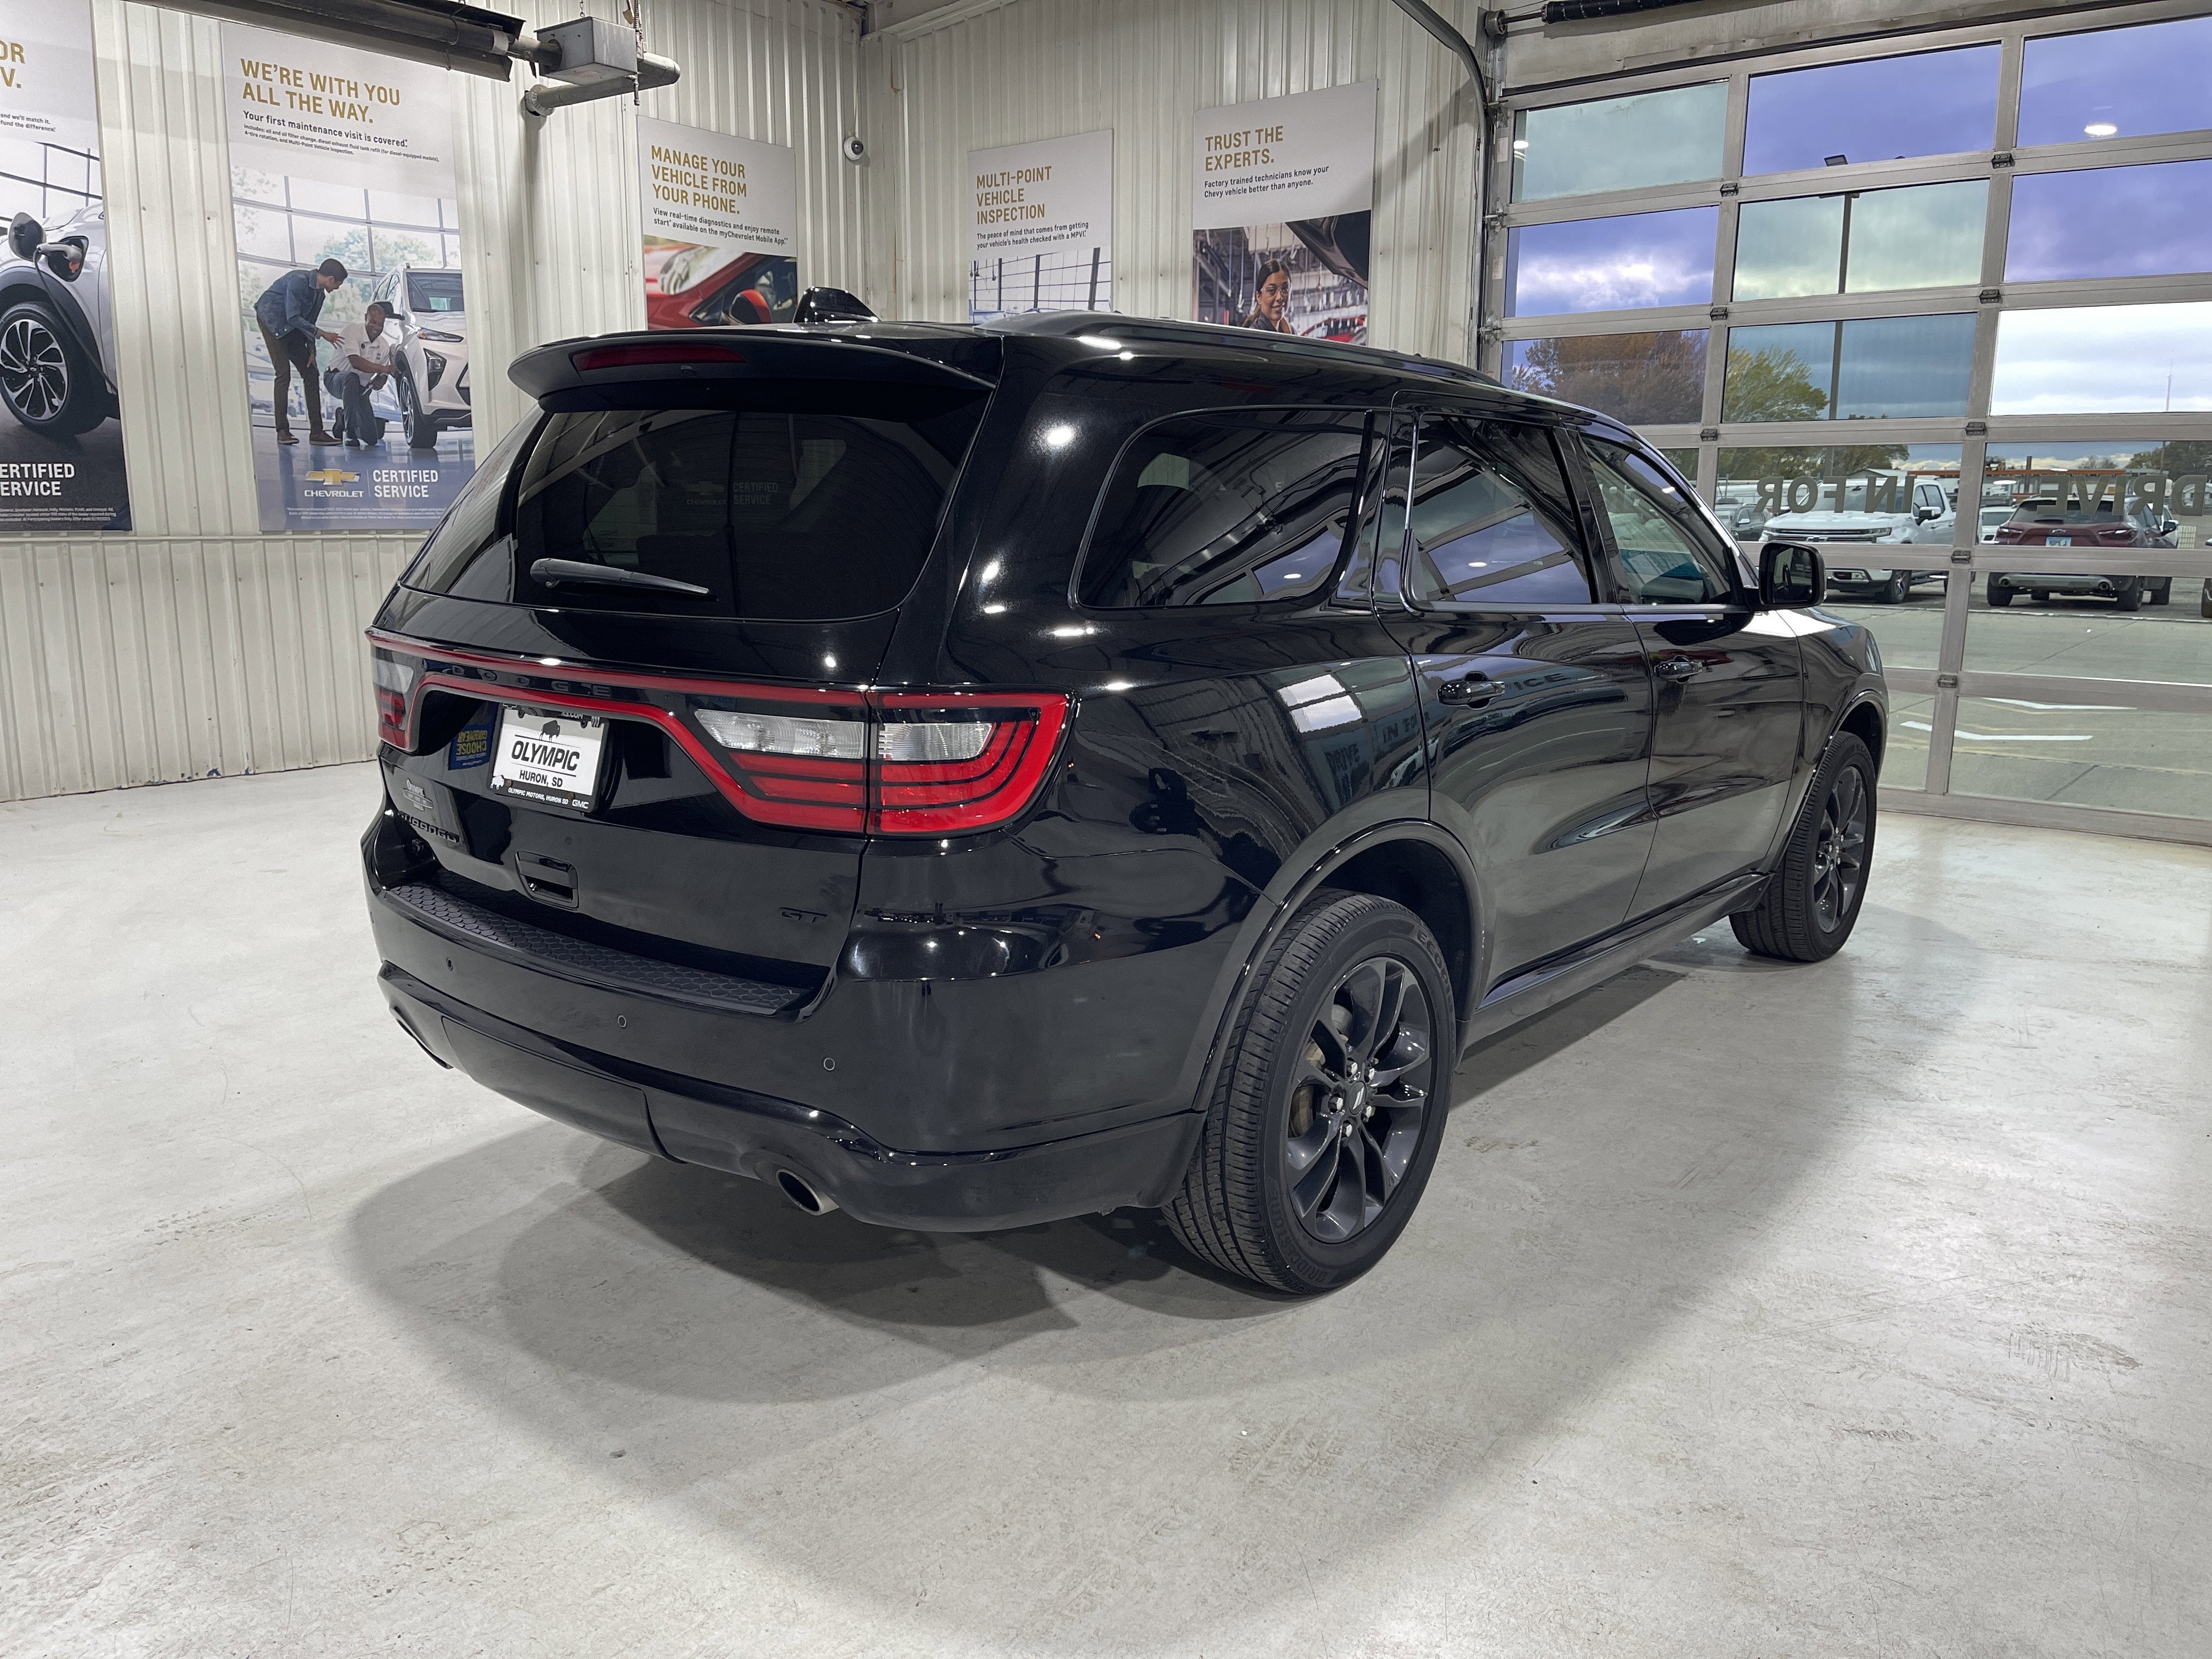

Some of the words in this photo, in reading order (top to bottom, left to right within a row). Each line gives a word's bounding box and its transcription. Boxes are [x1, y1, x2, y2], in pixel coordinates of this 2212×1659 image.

[241, 58, 303, 88] WE'RE
[309, 72, 358, 99] WITH
[364, 83, 400, 106] YOU
[242, 82, 280, 106] ALL
[285, 90, 323, 114] THE
[329, 99, 373, 123] WAY.
[243, 110, 264, 122] Your
[266, 115, 286, 126] first
[288, 121, 343, 137] maintenance
[344, 130, 363, 140] visit
[364, 133, 371, 142] is
[1205, 131, 1251, 152] TRUST
[1255, 126, 1284, 145] THE
[651, 145, 708, 172] MANAGE
[711, 158, 746, 179] YOUR
[1205, 148, 1274, 172] EXPERTS.
[651, 164, 708, 190] VEHICLE
[712, 177, 747, 198] FROM
[977, 166, 1052, 189] MULTI-POINT
[1204, 179, 1228, 188] Factory
[1230, 176, 1253, 185] trained
[1255, 171, 1293, 182] technicians
[1294, 167, 1312, 177] know
[1313, 166, 1329, 176] your
[652, 183, 689, 205] YOUR
[693, 192, 740, 215] PHONE.
[977, 188, 1024, 207] VEHICLE
[1204, 189, 1223, 199] Chevy
[1225, 187, 1247, 196] vehicle
[1249, 184, 1269, 193] better
[1271, 182, 1286, 190] than
[1287, 179, 1314, 189] anyone.
[653, 207, 668, 217] View
[669, 211, 697, 222] real-time
[699, 218, 732, 229] diagnostics
[744, 225, 759, 234] enjoy
[760, 227, 780, 235] remote
[977, 204, 1045, 225] INSPECTION
[673, 221, 698, 233] available
[719, 230, 754, 242] myChevrolet
[755, 235, 773, 243] Mobile
[987, 231, 1002, 240] peace
[1069, 221, 1089, 231] getting
[977, 242, 988, 250] your
[990, 239, 1011, 248] vehicle's
[1030, 235, 1052, 244] checked
[0, 463, 75, 478] ERTIFIED
[373, 469, 438, 483] CERTIFIED
[0, 481, 62, 496] ERVICE
[304, 489, 364, 498] CHEVROLET
[374, 485, 429, 498] SERVICE
[733, 482, 778, 493] CERTIFIED
[733, 495, 771, 505] SERVICE
[511, 740, 580, 771] OLYMPIC
[519, 770, 549, 787] HURON,
[551, 776, 563, 787] SD
[507, 787, 526, 796] OLYMPIC
[526, 791, 545, 802] MOTORS,
[545, 795, 561, 804] HURON
[572, 799, 589, 809] GMC
[778, 907, 827, 923] GT
